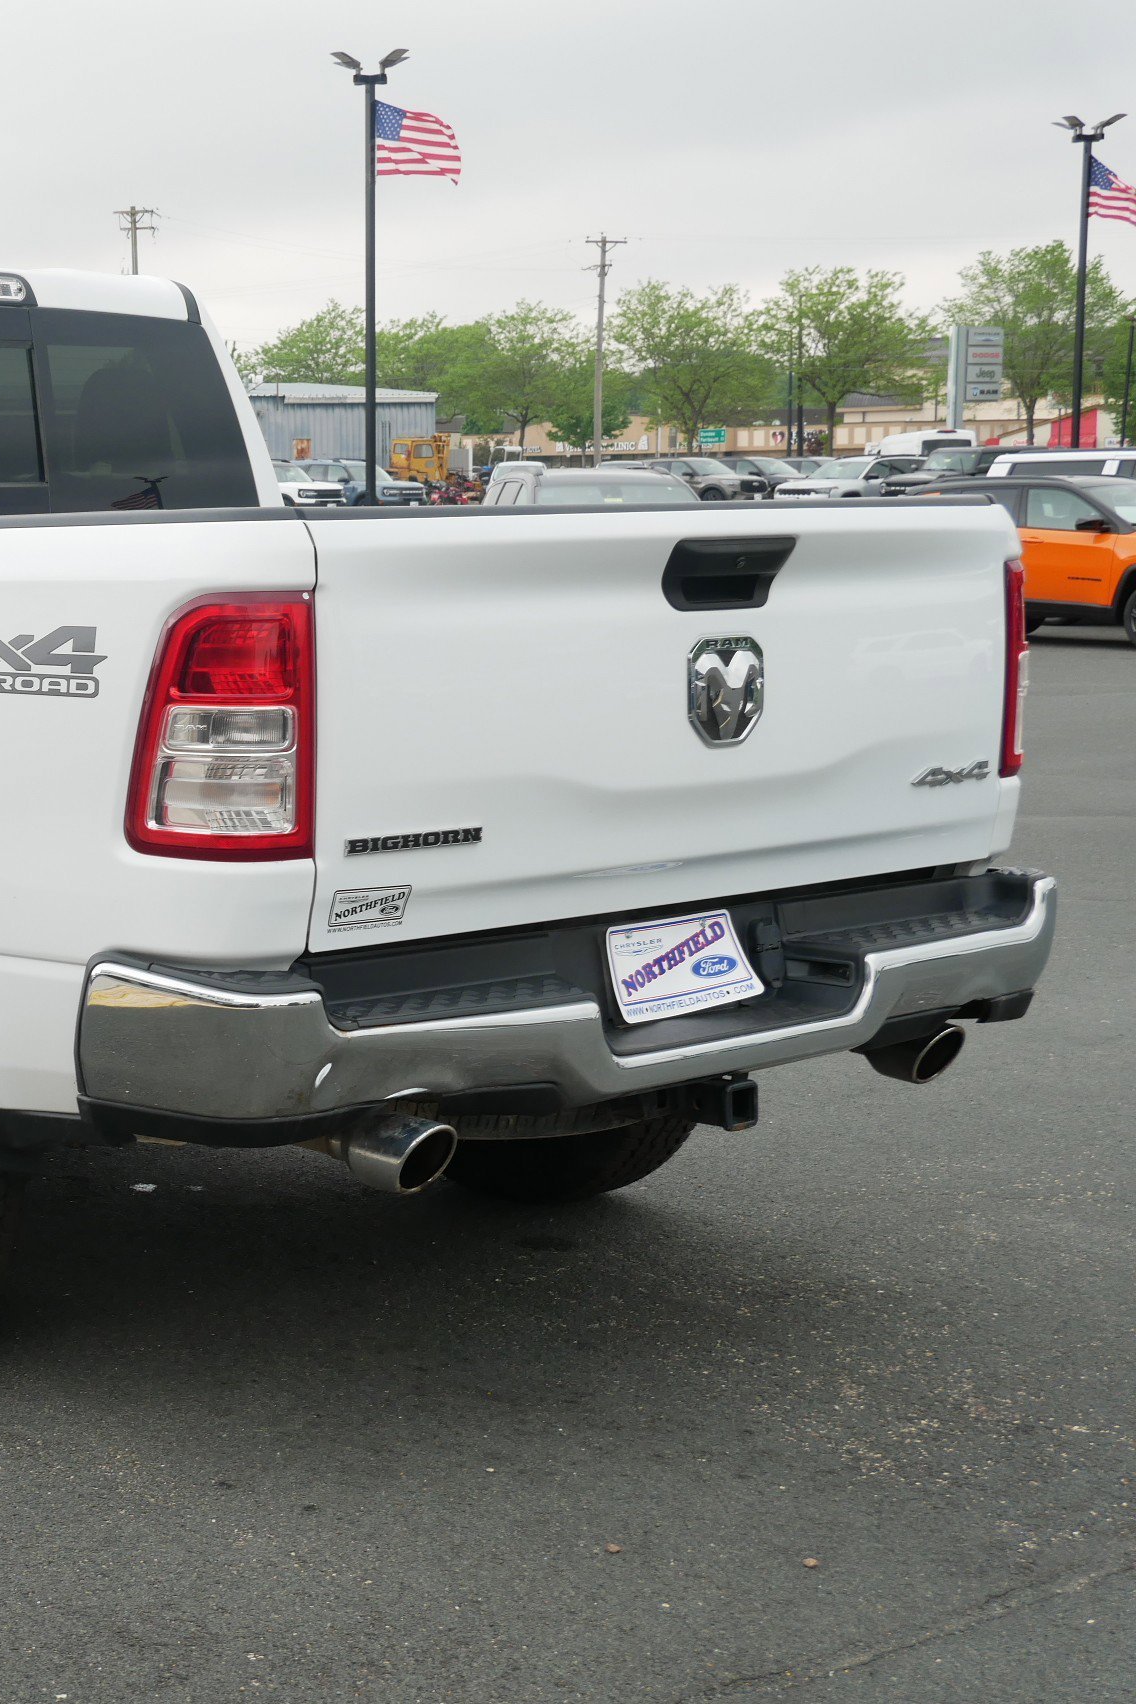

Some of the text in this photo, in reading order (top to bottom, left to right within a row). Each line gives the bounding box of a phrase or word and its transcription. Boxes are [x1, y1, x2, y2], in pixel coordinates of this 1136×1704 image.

[976, 367, 995, 379] Jeep
[608, 441, 636, 451] CLINIC
[705, 639, 750, 650] RAM
[334, 891, 406, 922] NORTHFIELD
[614, 938, 662, 950] CHRYSLER
[621, 920, 726, 997] NORTHFIELD
[700, 958, 730, 975] Ford
